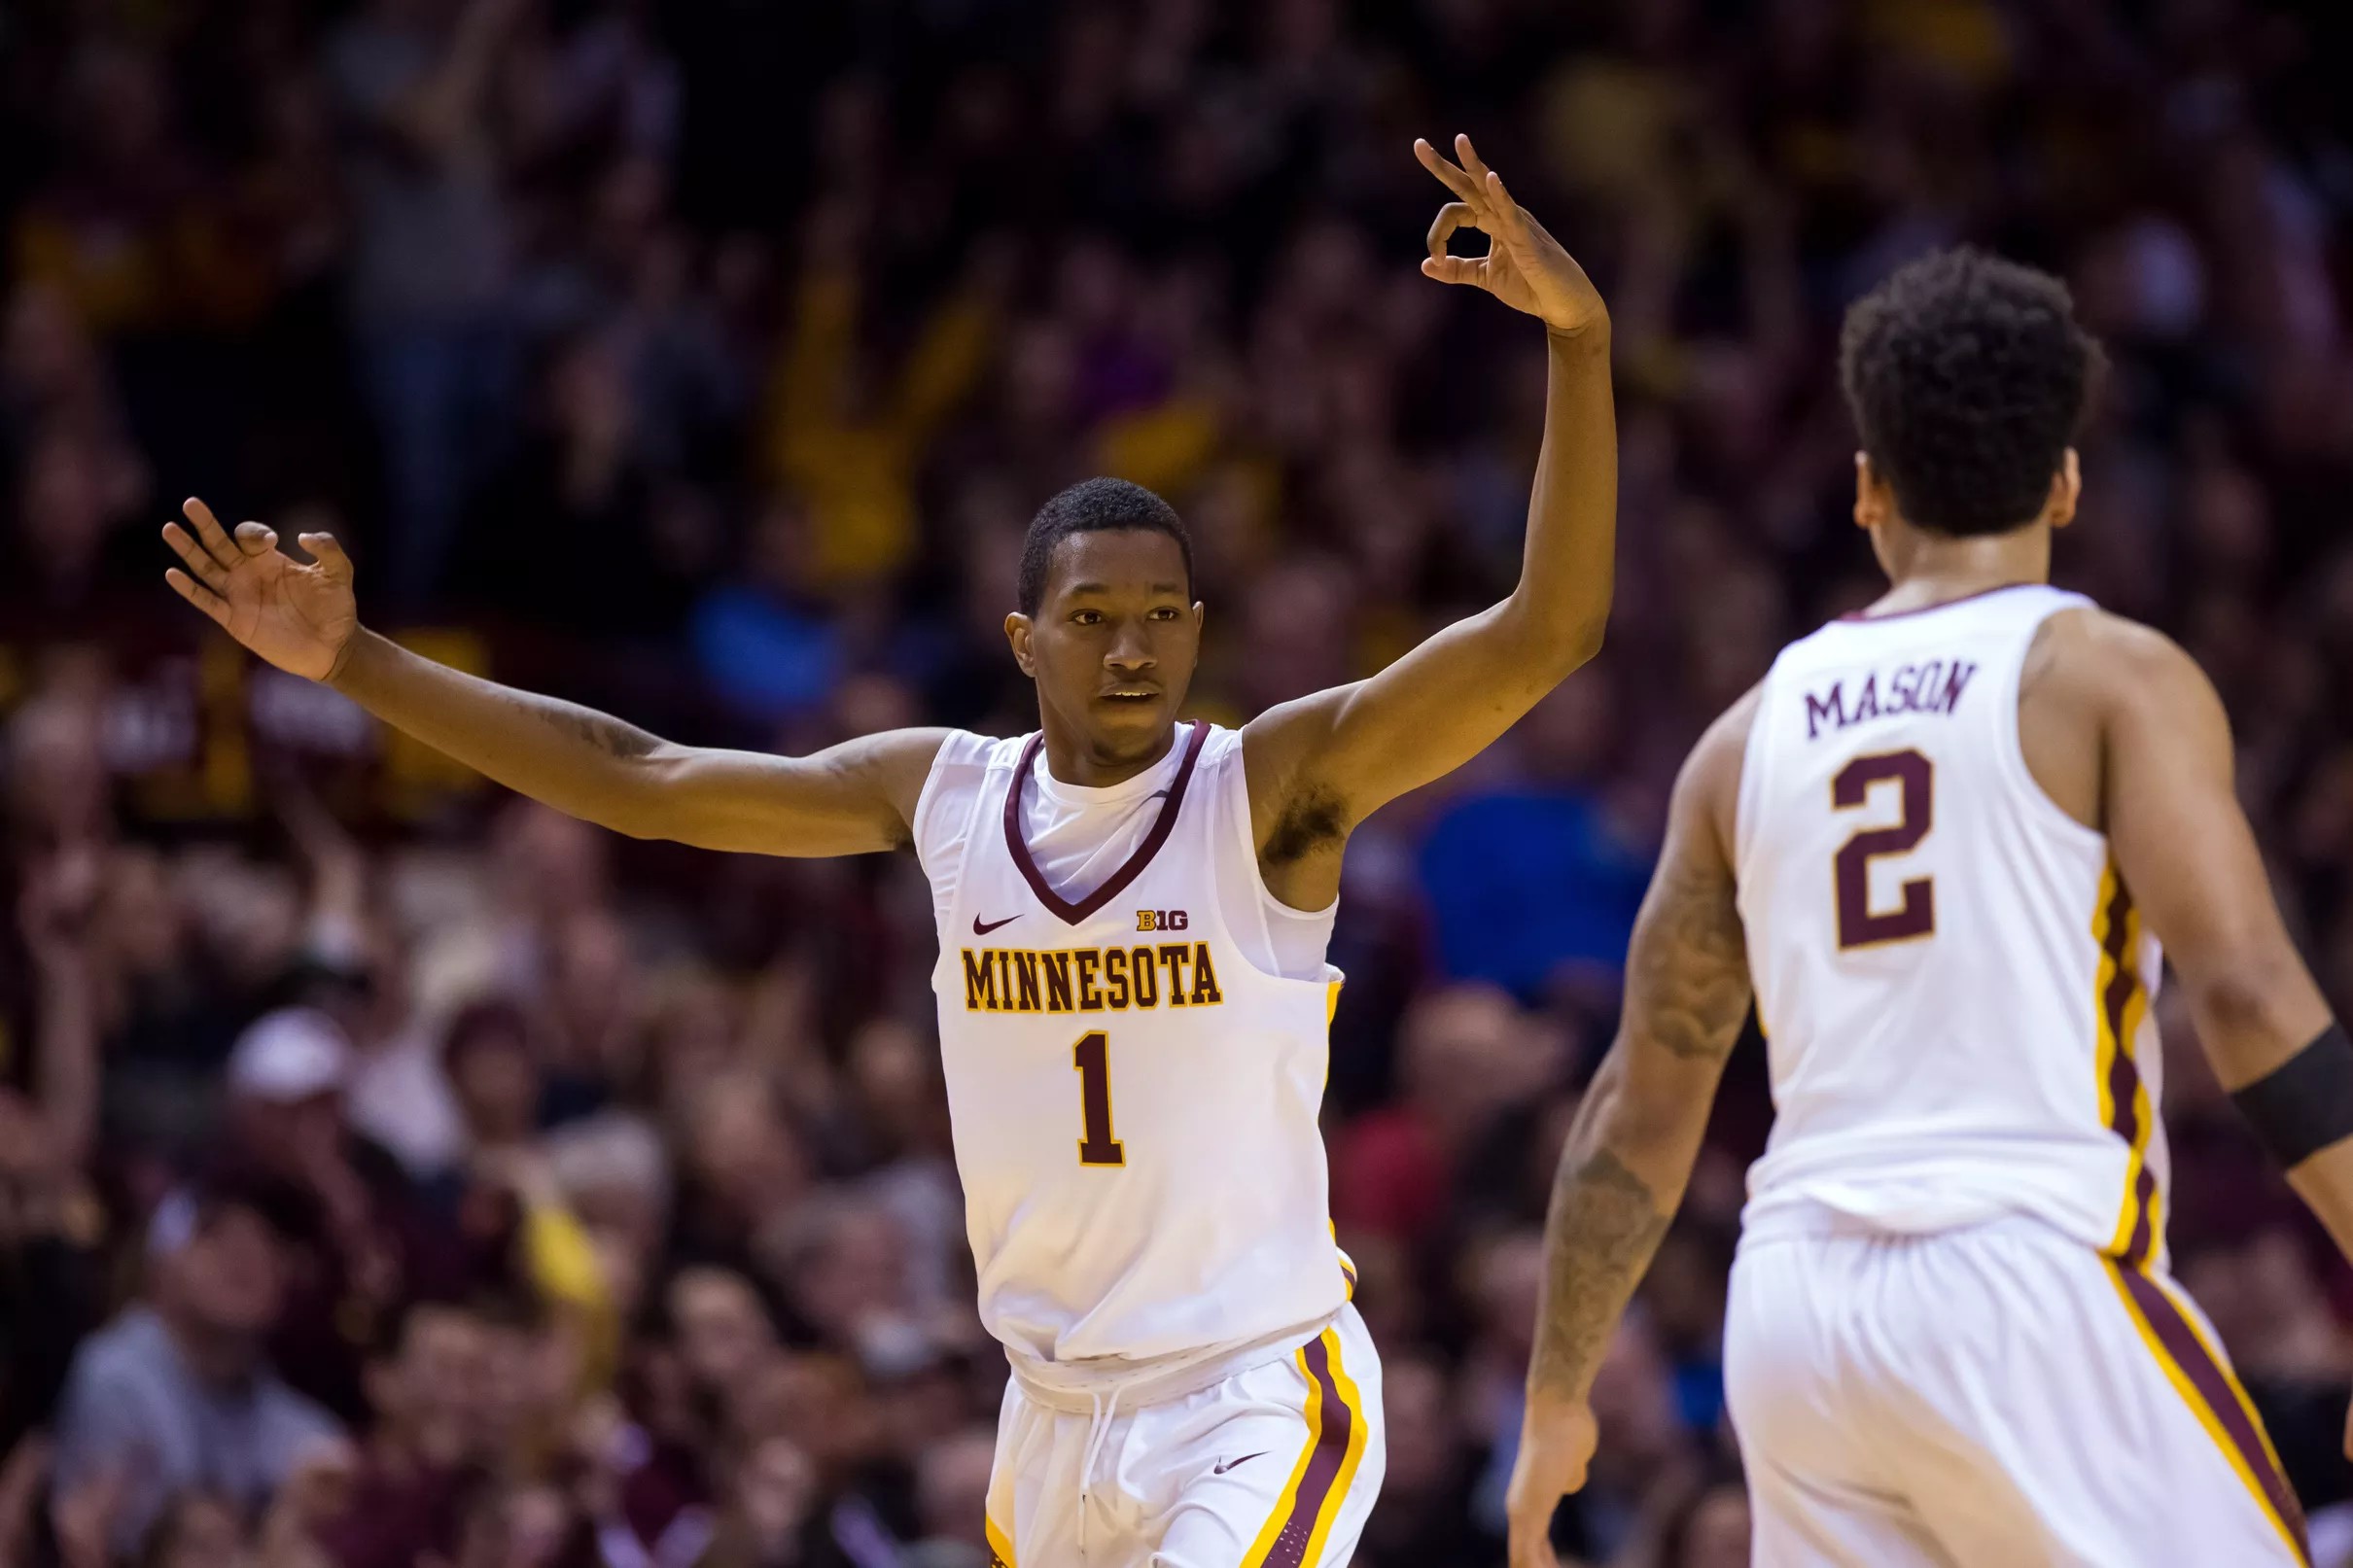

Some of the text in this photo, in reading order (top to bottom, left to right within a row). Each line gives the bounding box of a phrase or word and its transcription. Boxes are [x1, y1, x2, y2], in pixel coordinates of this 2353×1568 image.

[1805, 660, 1977, 739] MASON
[1830, 747, 1936, 953] 2
[961, 940, 1223, 1014] MINNESOTA
[1072, 1029, 1126, 1167] 1
